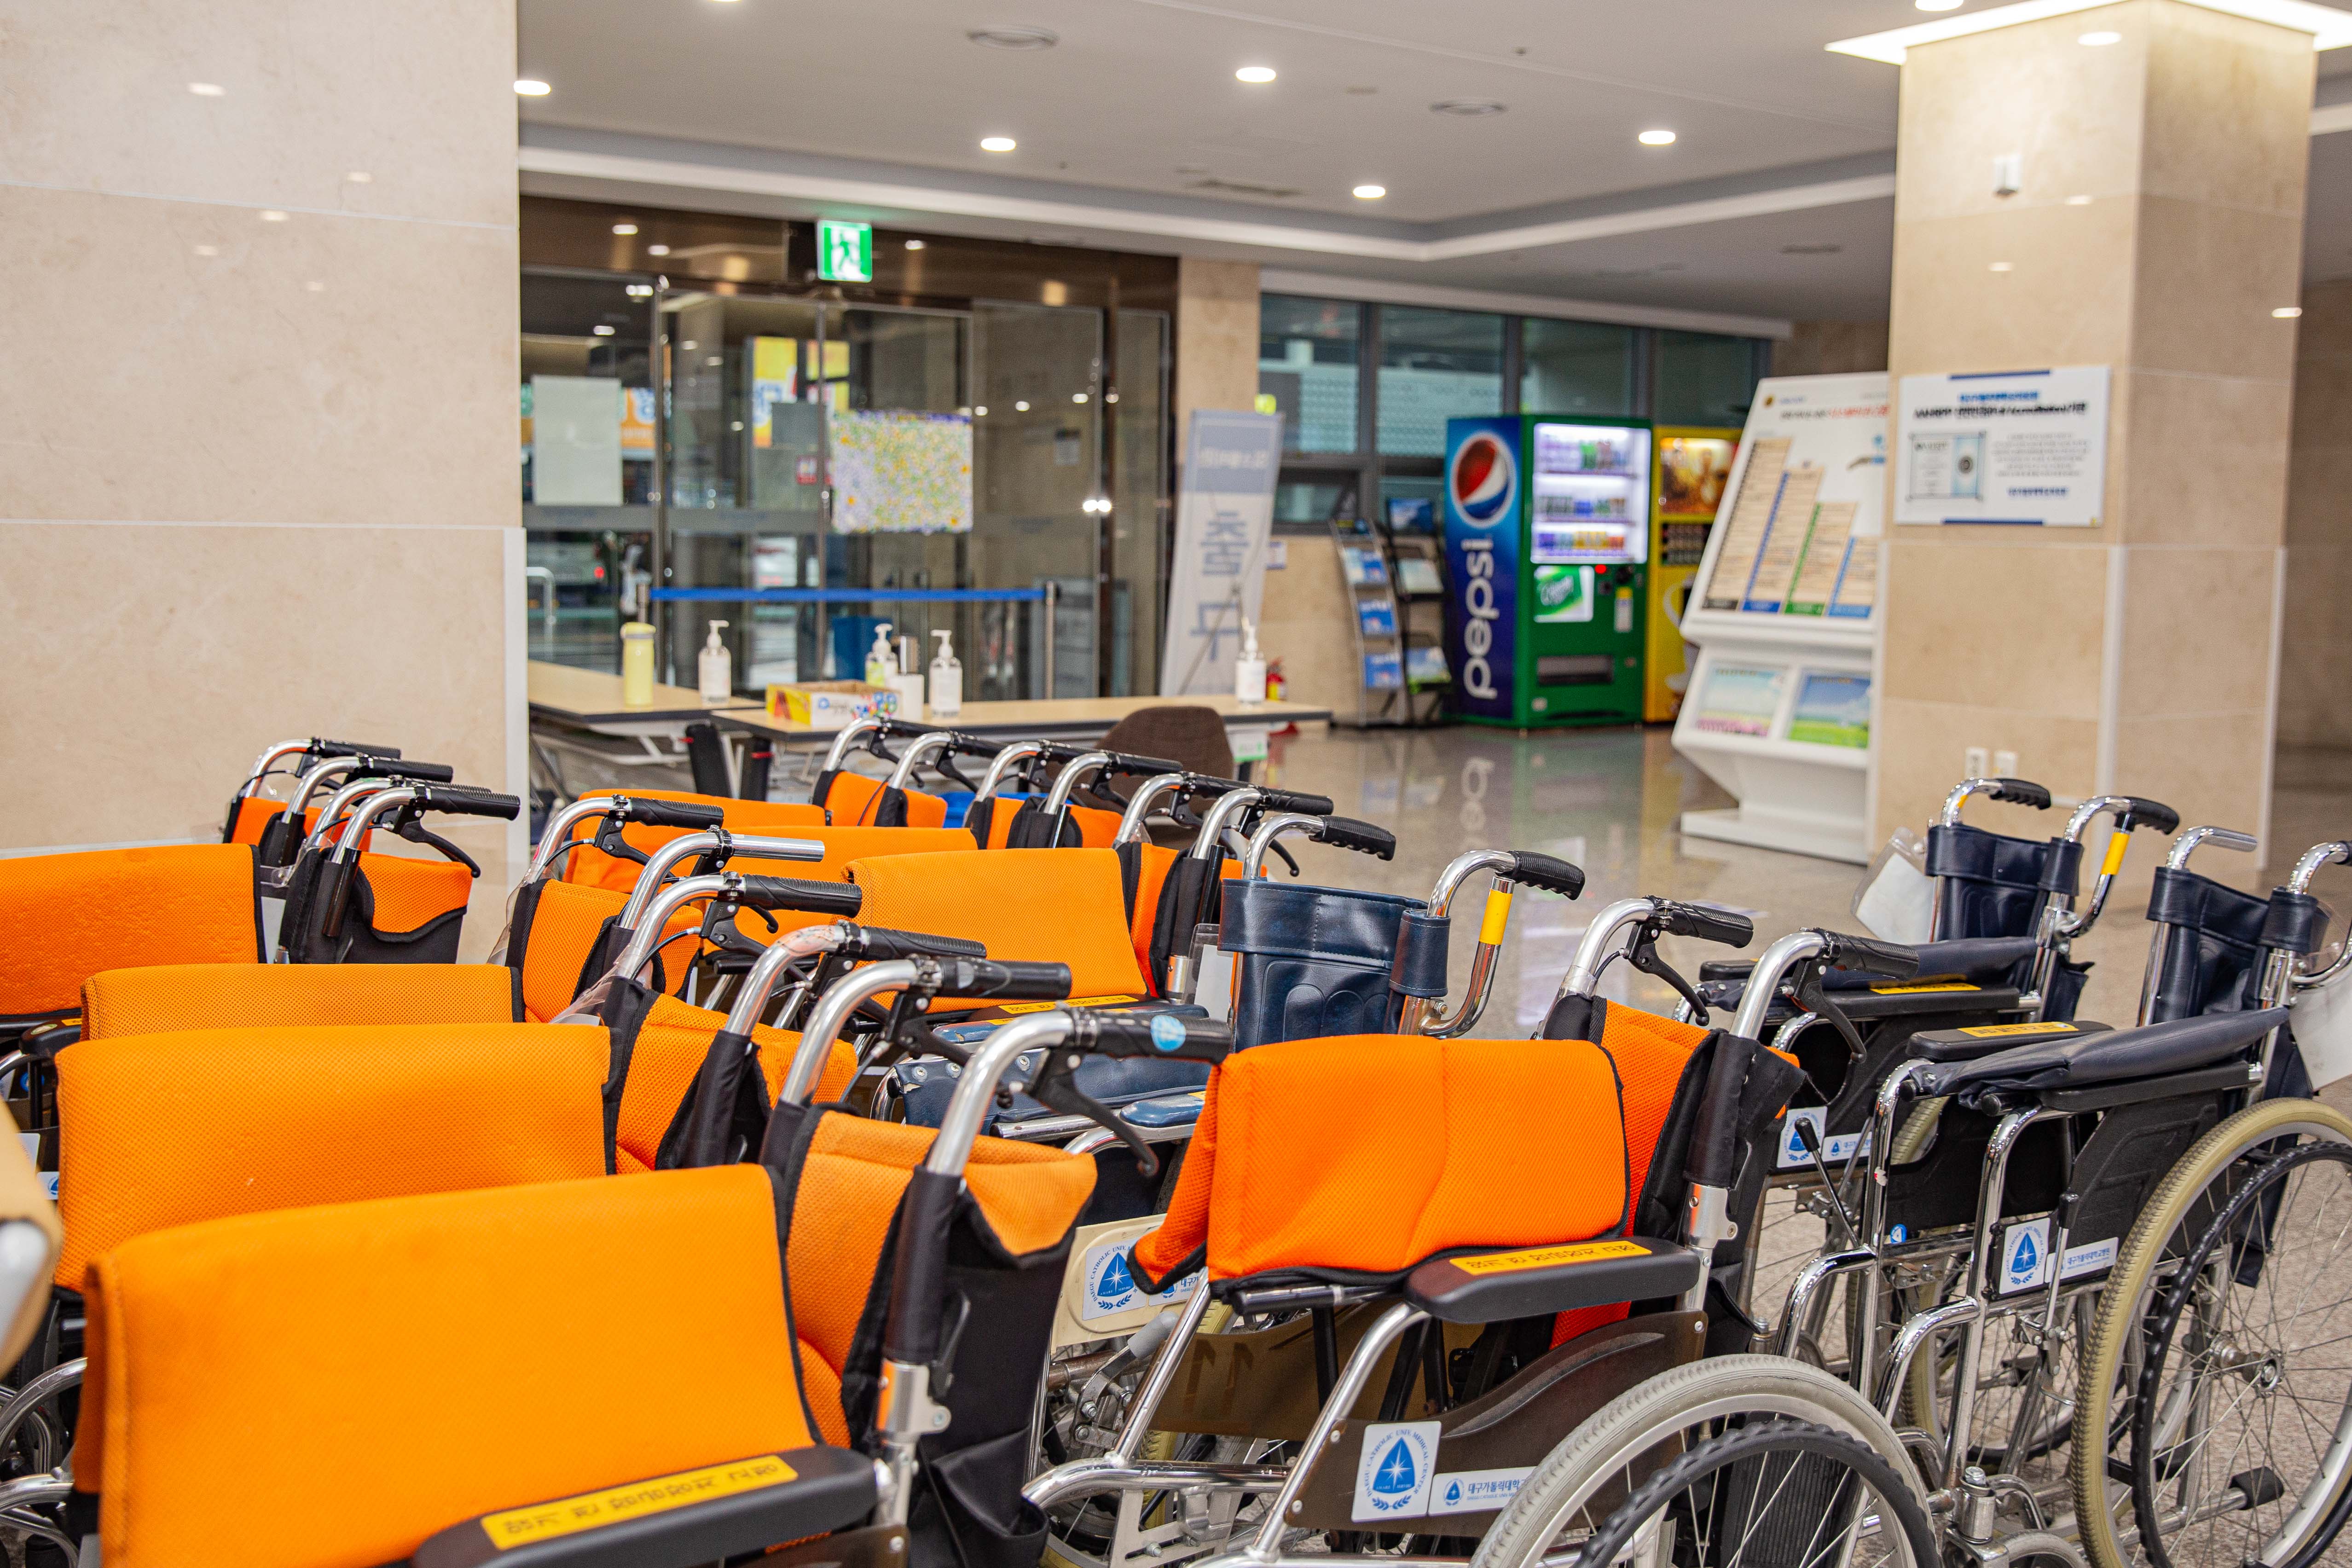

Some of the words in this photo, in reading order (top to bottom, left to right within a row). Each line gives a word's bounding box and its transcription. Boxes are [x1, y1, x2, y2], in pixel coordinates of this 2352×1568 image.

[1460, 537, 1498, 700] pepsi
[1090, 1250, 1111, 1279] CATHOLIC
[1089, 1281, 1098, 1302] DAEGU
[1366, 1432, 1394, 1467] CATHOLIC
[1413, 1432, 1429, 1462] MEDICAL
[1364, 1470, 1373, 1498] DAEGU
[1414, 1463, 1429, 1494] CENTER
